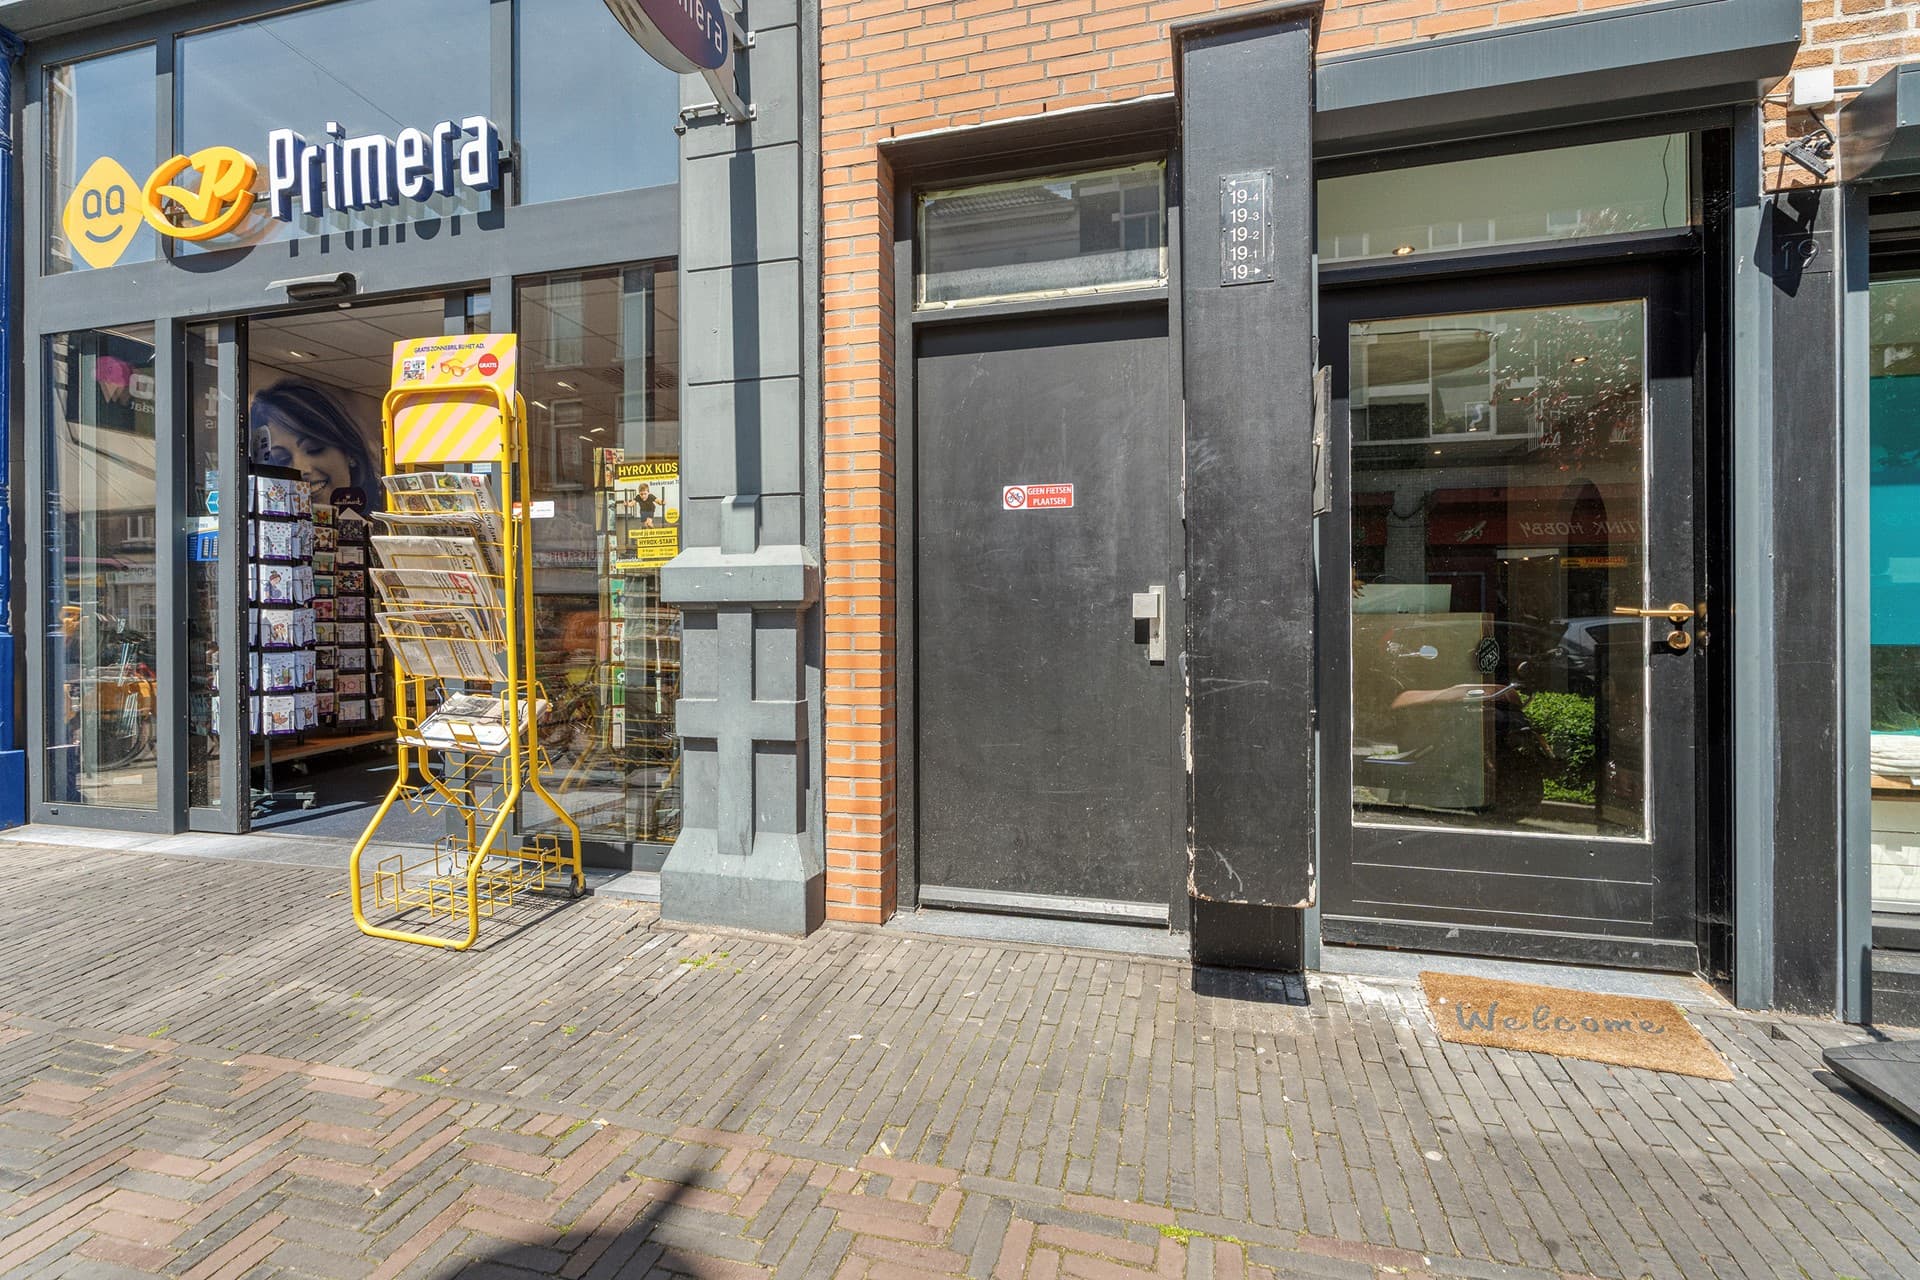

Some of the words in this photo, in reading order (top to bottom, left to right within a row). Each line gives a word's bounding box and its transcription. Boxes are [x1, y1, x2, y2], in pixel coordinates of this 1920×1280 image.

[269, 115, 497, 221] Primera
[1230, 189, 1259, 204] 19-4
[1230, 208, 1260, 223] 19-3
[1230, 227, 1260, 242] 19-2
[1230, 246, 1258, 261] 19-1
[1781, 239, 1820, 270] 19
[1230, 265, 1248, 280] 19
[618, 464, 653, 476] HYROX
[655, 462, 678, 474] KIDS
[1028, 487, 1045, 495] GEEN
[1046, 485, 1072, 494] FIETSEN
[1033, 497, 1067, 506] PLAATSEN
[1455, 1001, 1664, 1034] Welcome
